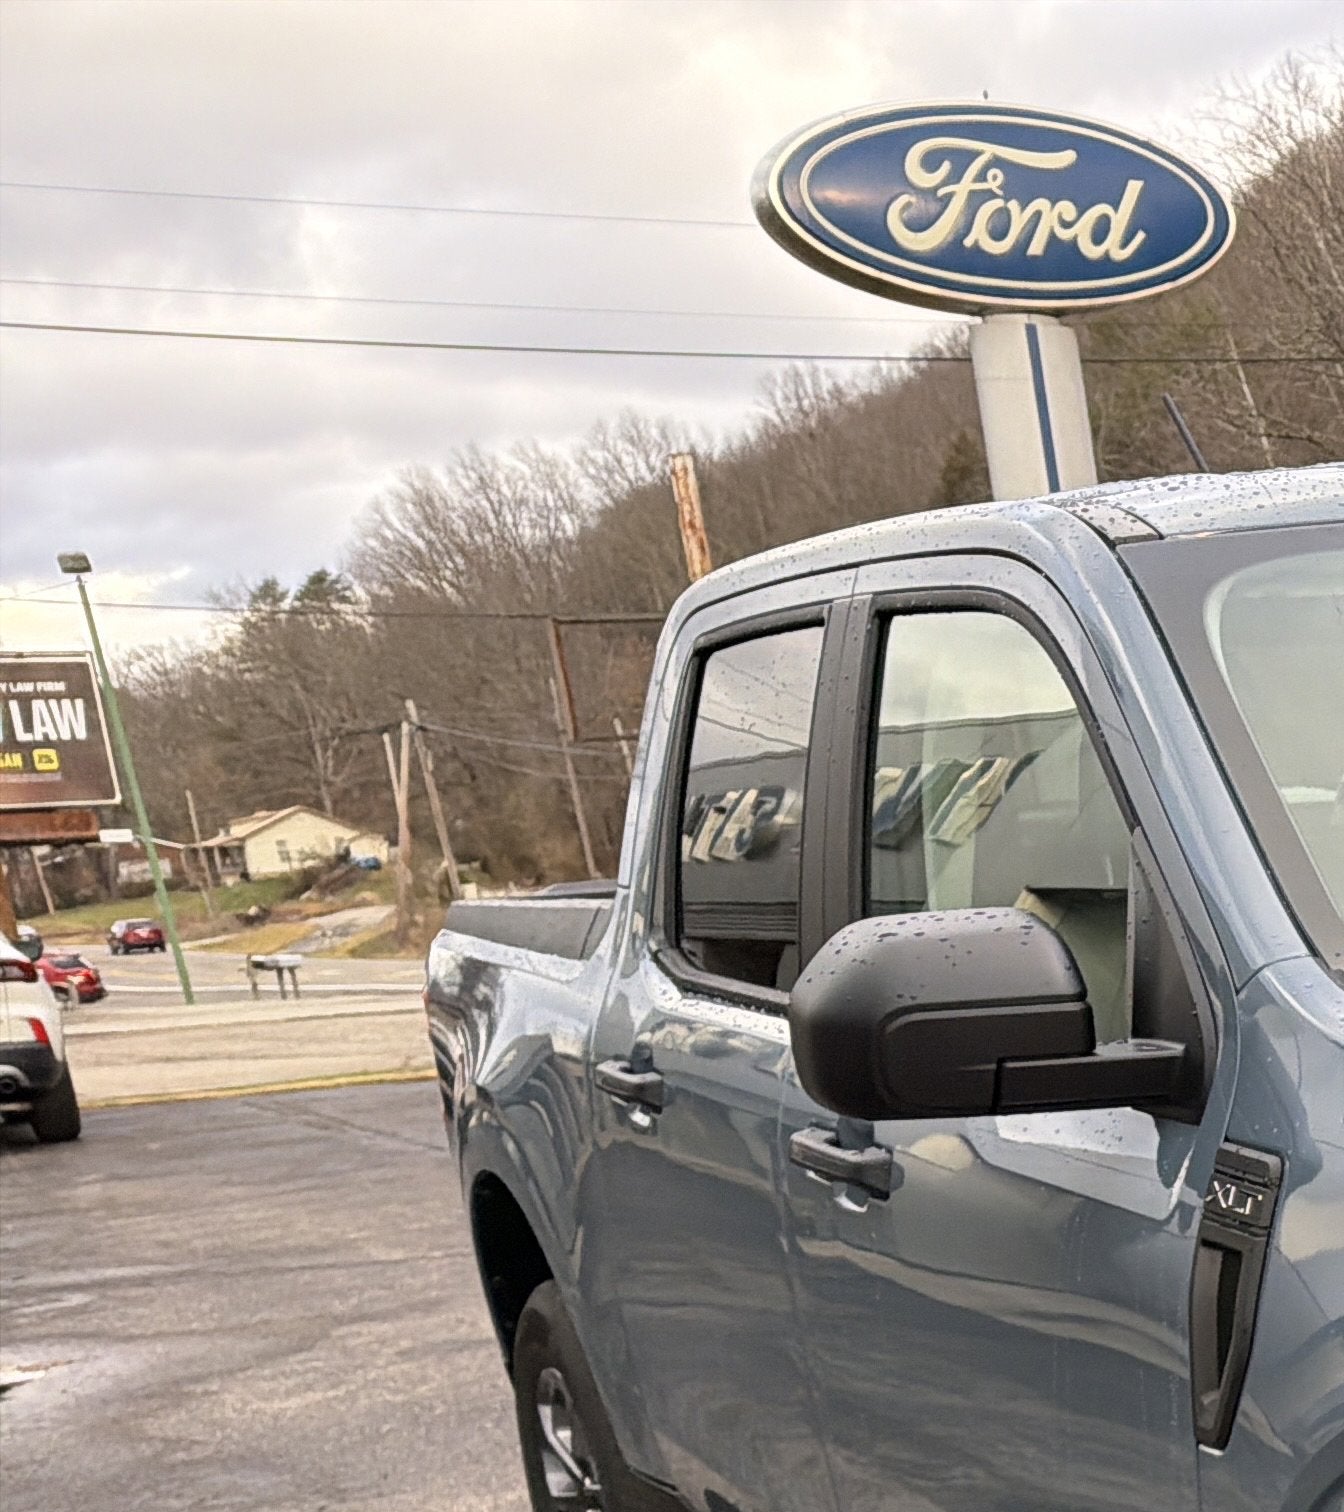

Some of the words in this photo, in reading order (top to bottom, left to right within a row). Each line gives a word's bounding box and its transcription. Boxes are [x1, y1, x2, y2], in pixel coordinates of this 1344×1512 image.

[886, 136, 1147, 262] Ford
[9, 681, 34, 693] LAW
[36, 681, 66, 692] FIRM
[8, 698, 87, 741] LAW
[1204, 1180, 1264, 1215] XLT
